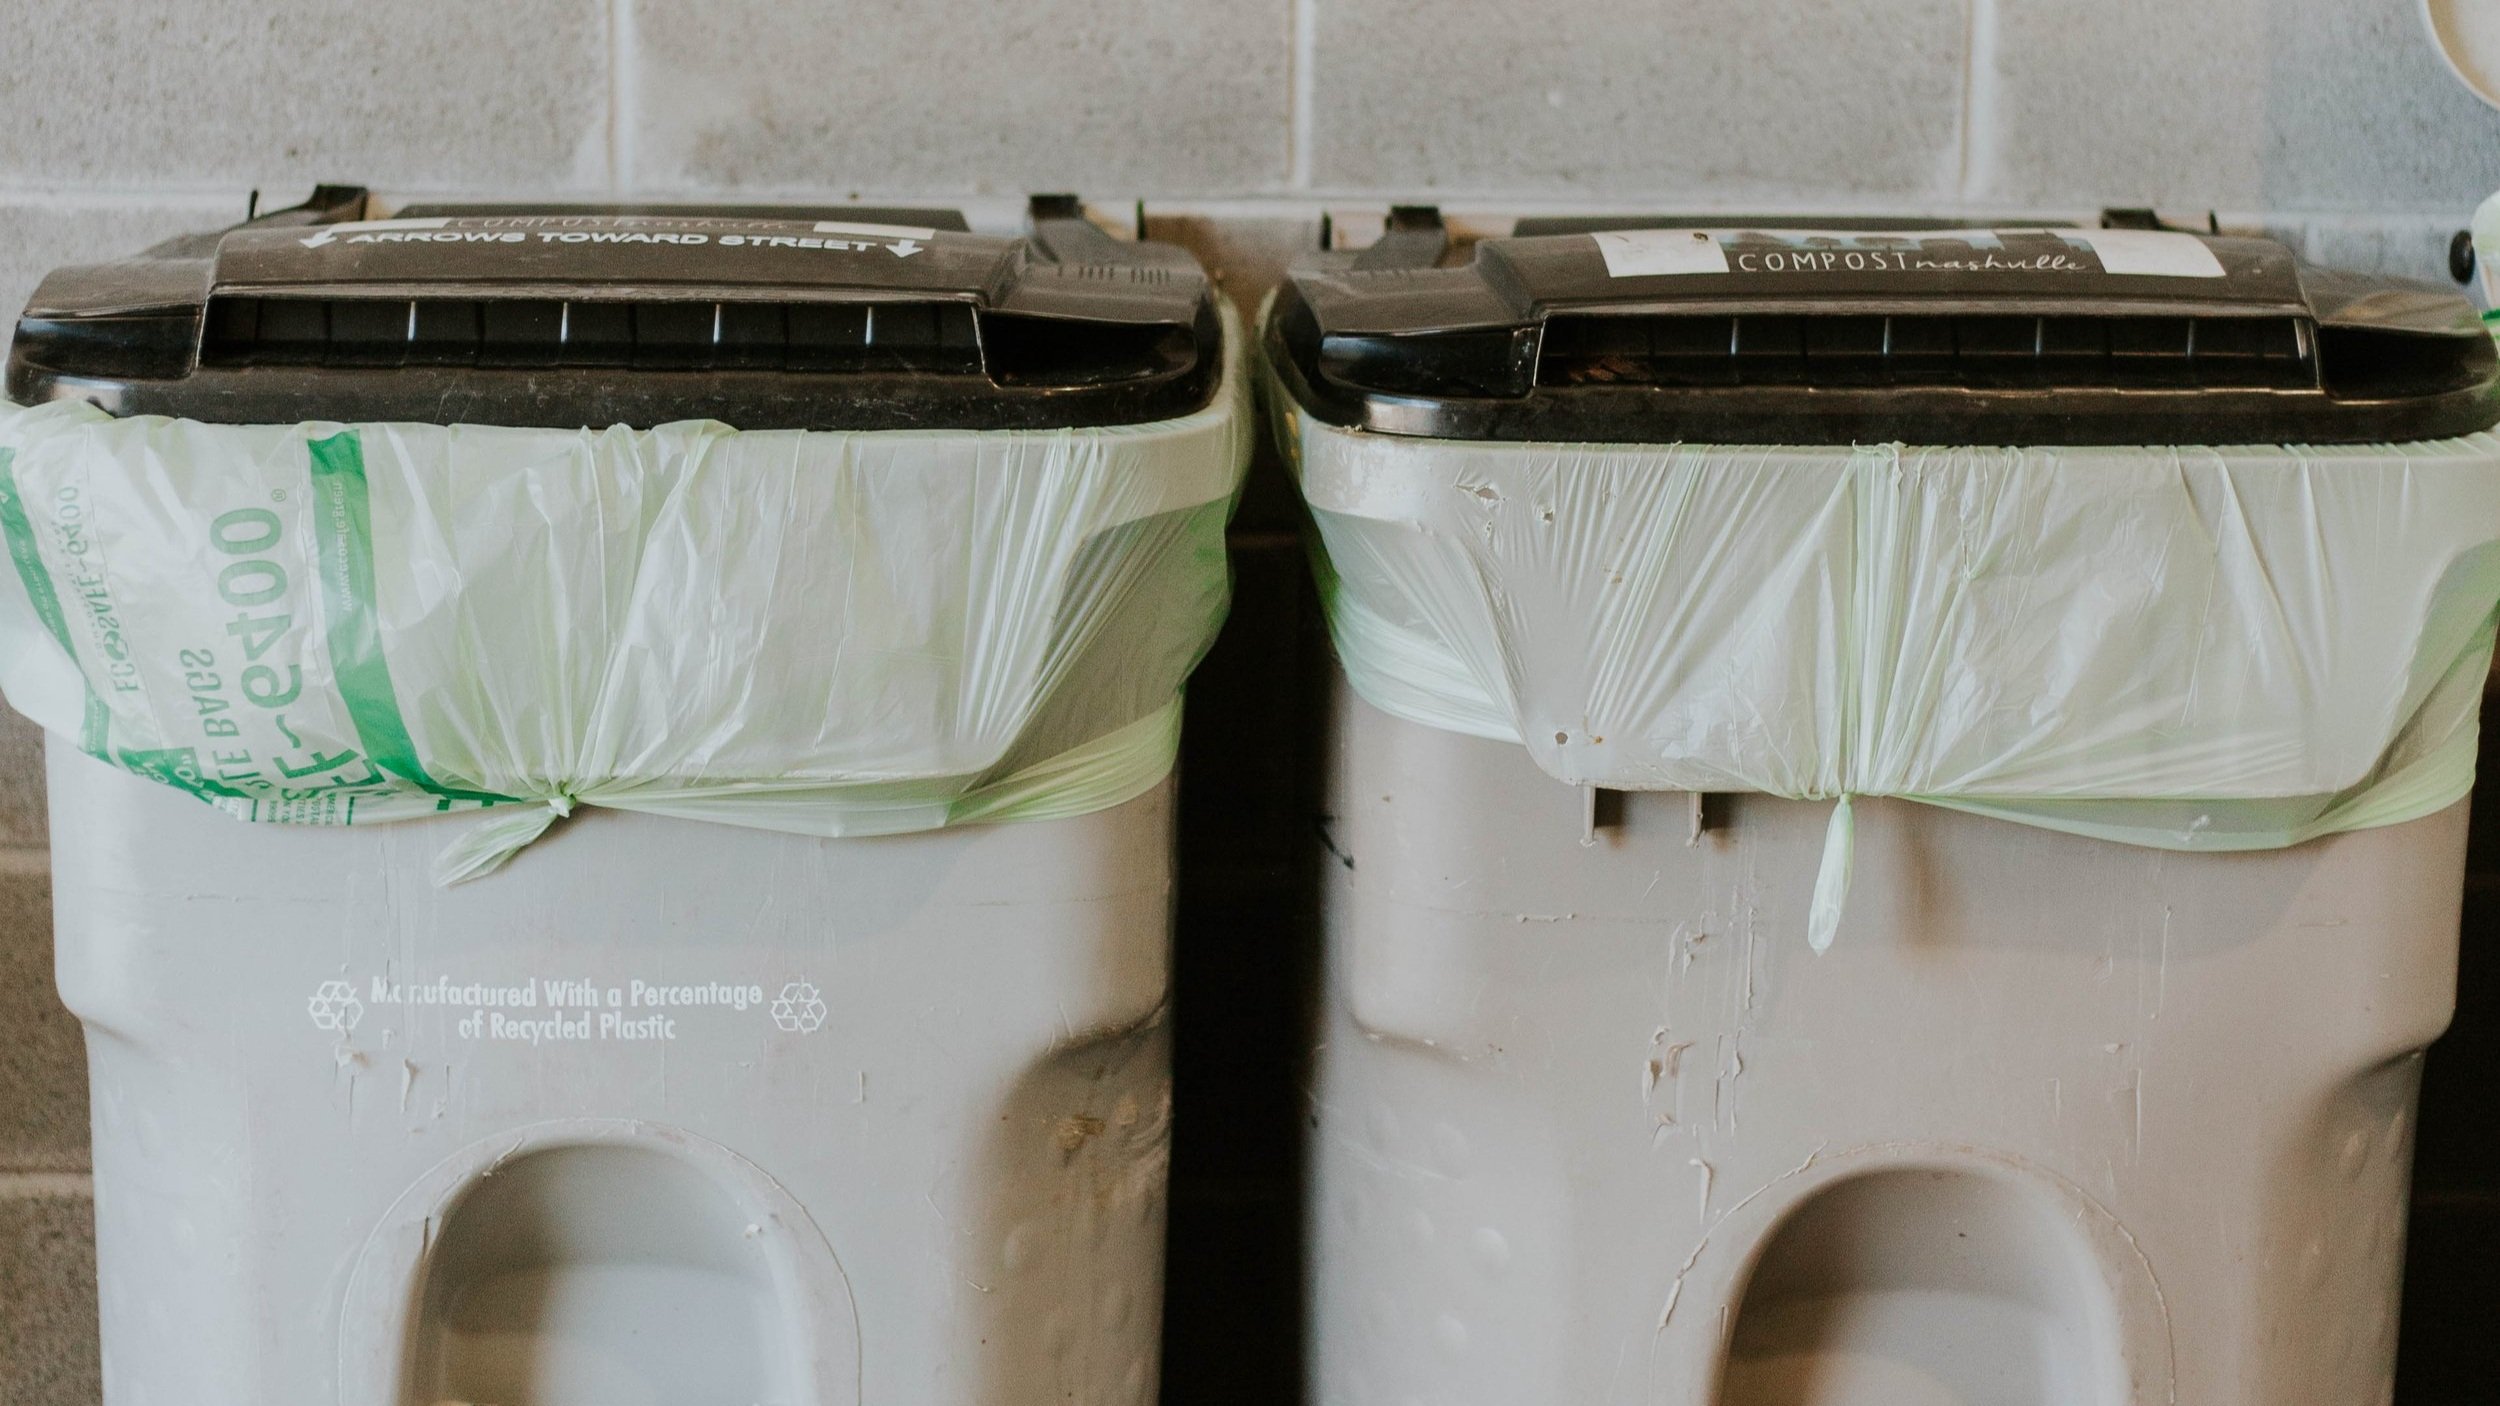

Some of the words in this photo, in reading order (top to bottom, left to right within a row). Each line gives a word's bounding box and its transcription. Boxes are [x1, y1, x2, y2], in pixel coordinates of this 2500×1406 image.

[346, 231, 526, 244] ARROWS
[537, 231, 709, 246] TOWARD
[718, 234, 878, 252] STREET
[370, 975, 537, 1007] Manufactured
[544, 978, 599, 1007] With
[607, 988, 622, 1007] a
[630, 979, 763, 1010] Percentage
[458, 1009, 483, 1039] of
[490, 1010, 591, 1046] Recycled
[600, 1010, 676, 1039] Plastic
